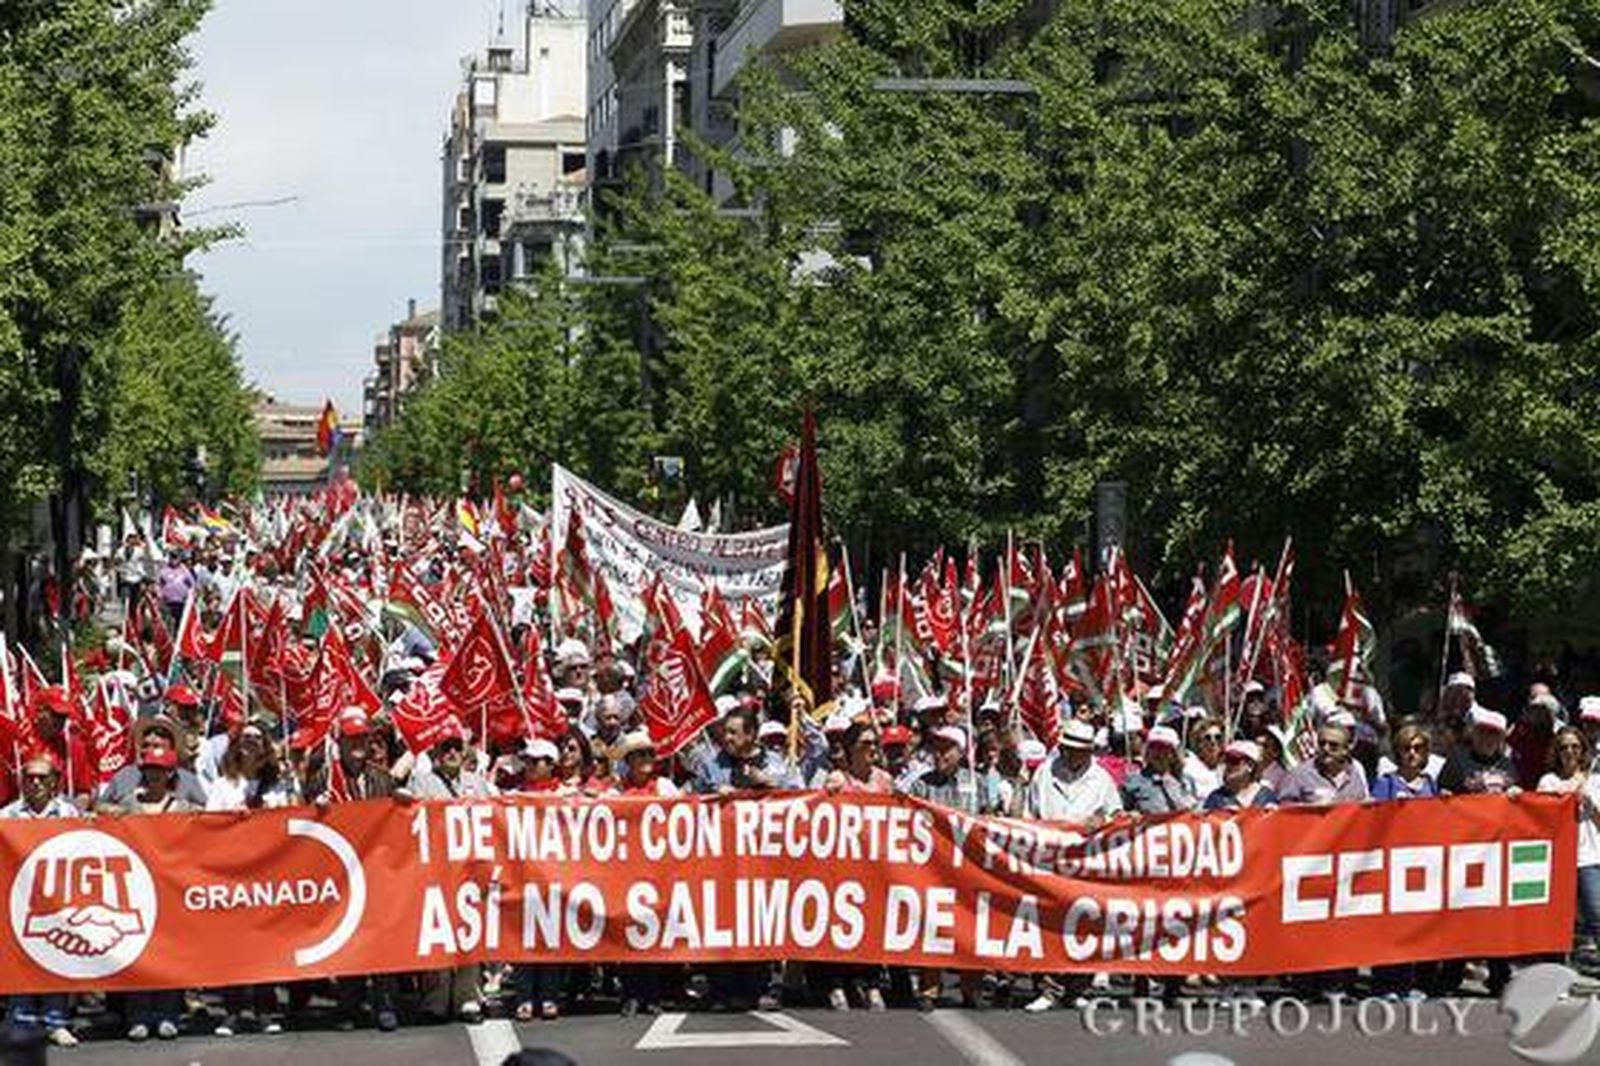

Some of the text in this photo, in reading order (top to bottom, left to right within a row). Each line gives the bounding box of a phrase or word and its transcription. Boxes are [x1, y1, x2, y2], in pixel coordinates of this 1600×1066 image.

[411, 800, 1245, 879] 1 DE MAYO: CON RECORTES Y PRECARIEDAD
[29, 855, 135, 914] UGT
[185, 878, 341, 910] GRANADA
[417, 866, 1248, 963] ASÍ NO SALIMOS DE LA CRISIS
[1281, 841, 1503, 924] CCOO
